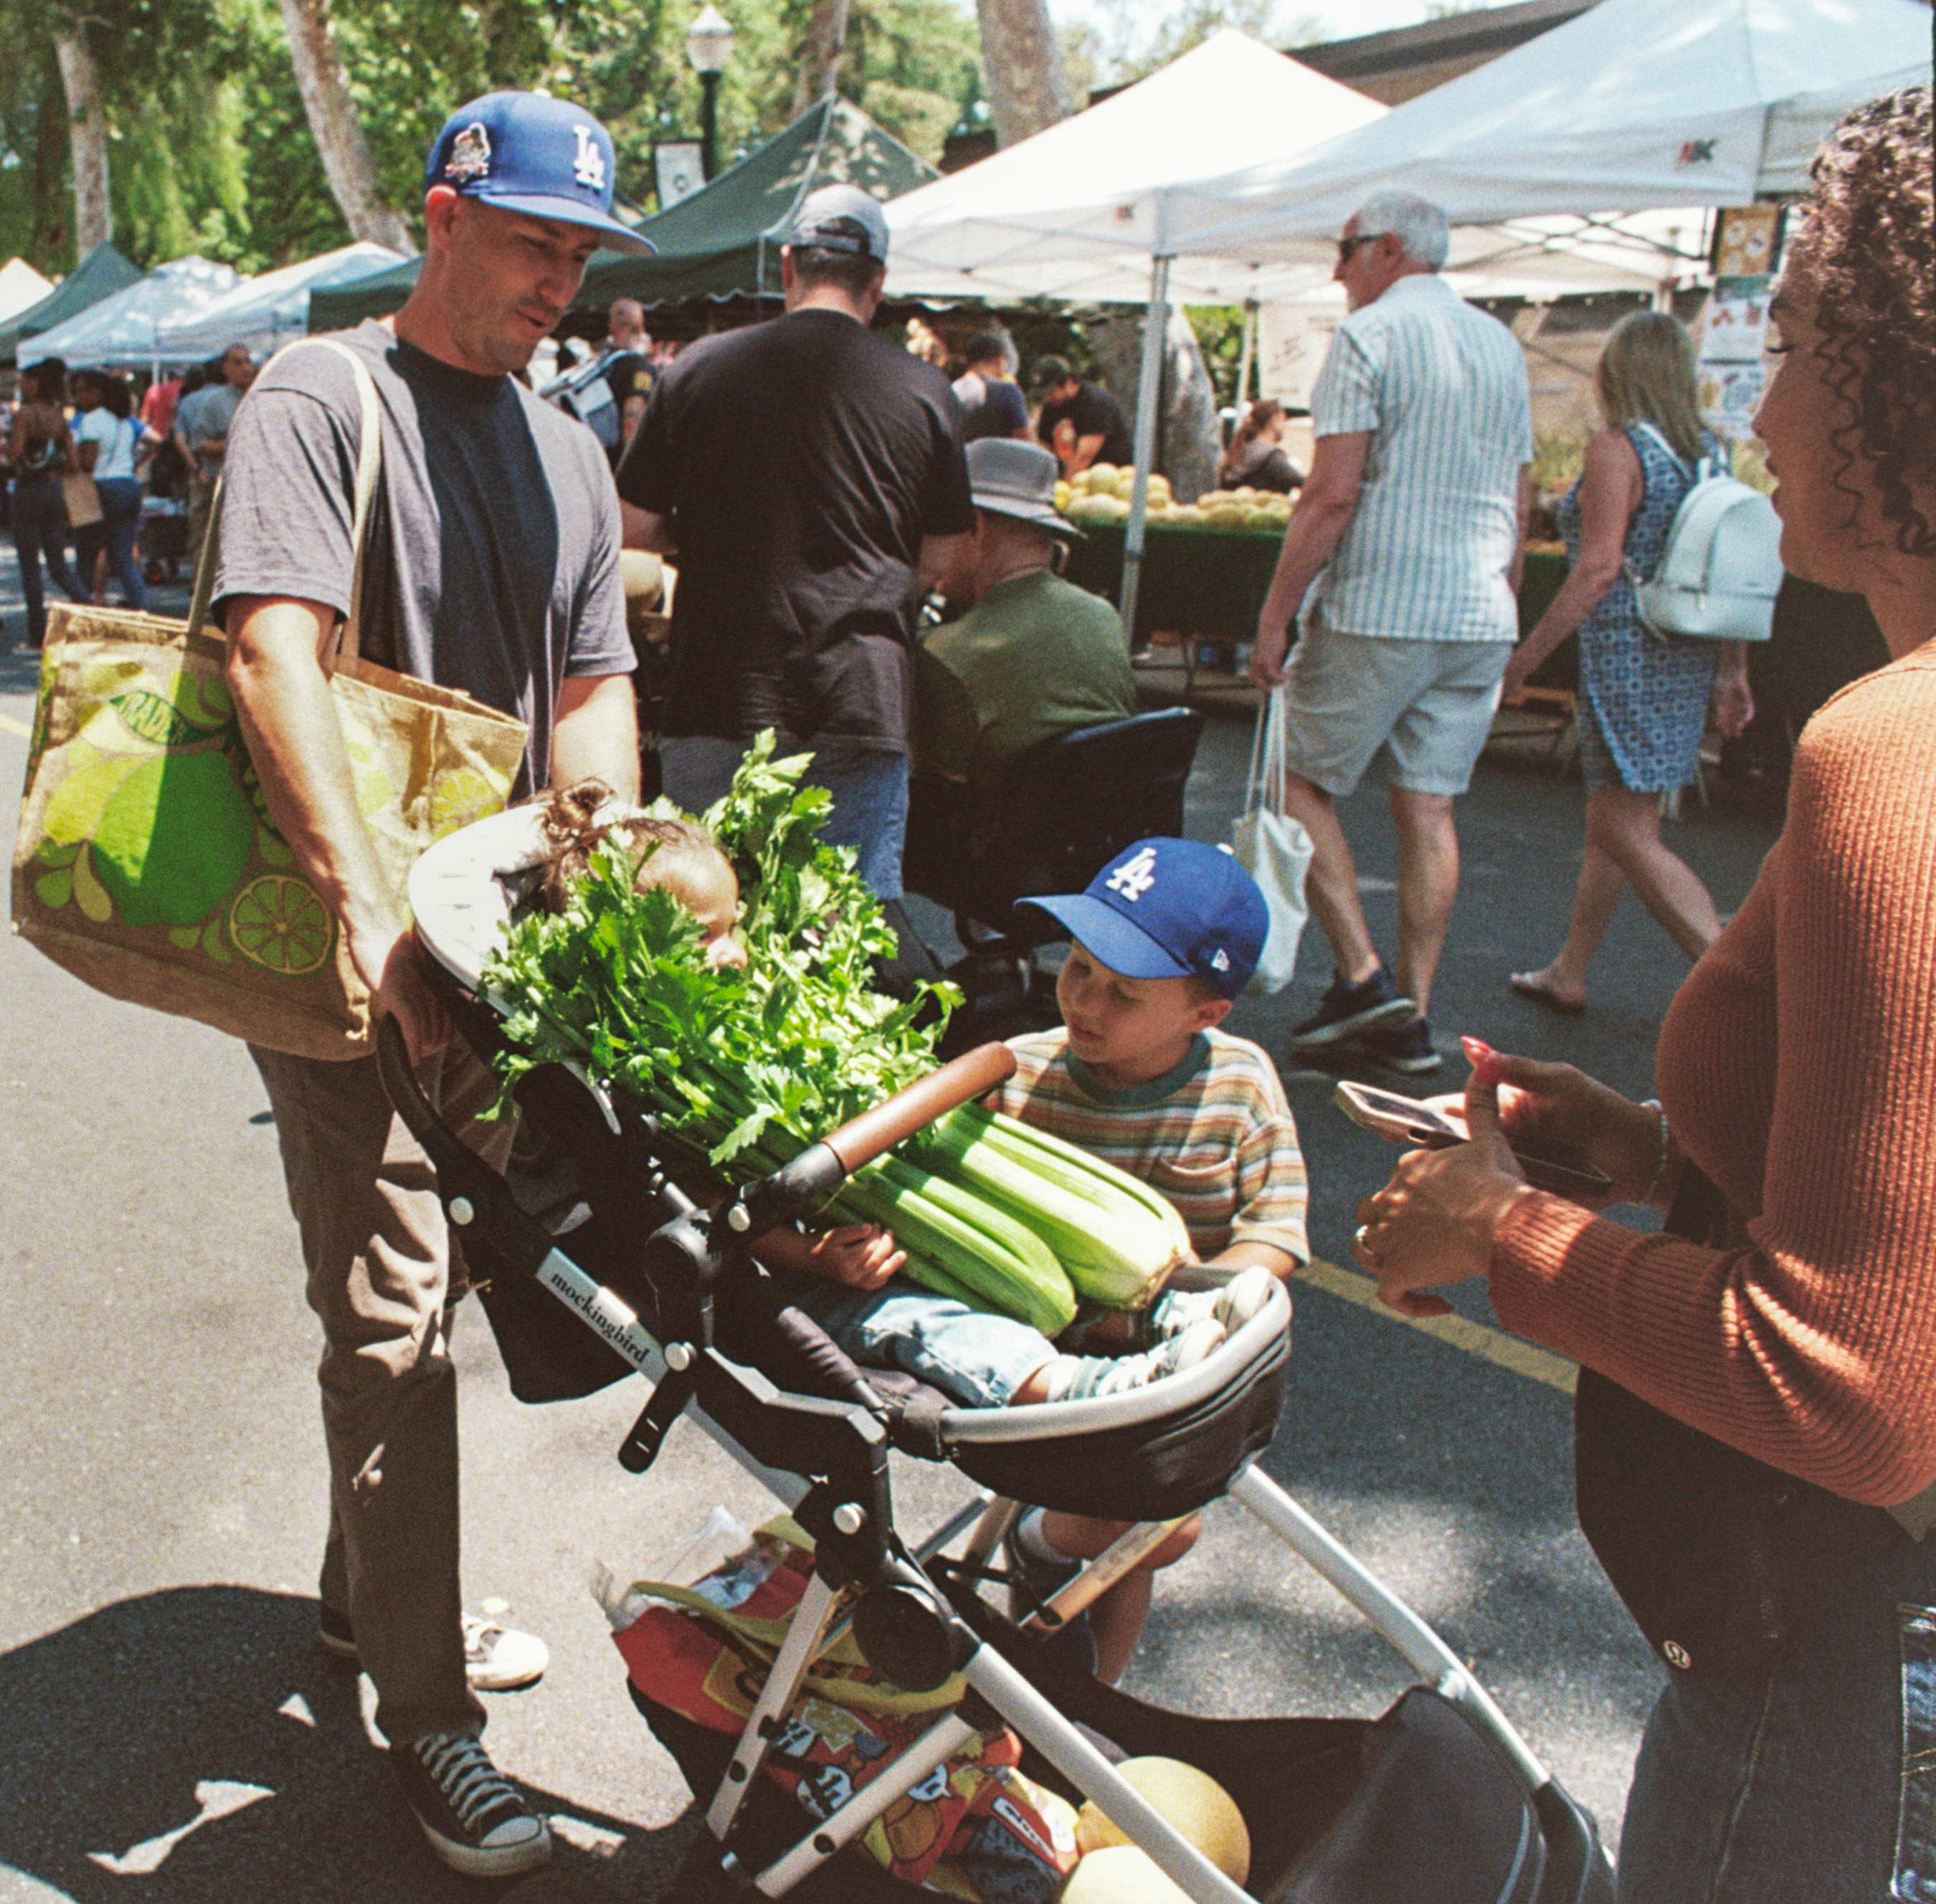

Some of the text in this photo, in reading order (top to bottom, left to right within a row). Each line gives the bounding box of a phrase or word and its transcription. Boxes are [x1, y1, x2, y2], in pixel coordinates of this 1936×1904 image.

[573, 124, 605, 190] LA
[1105, 847, 1157, 902] LA
[551, 1273, 650, 1363] mockingbird
